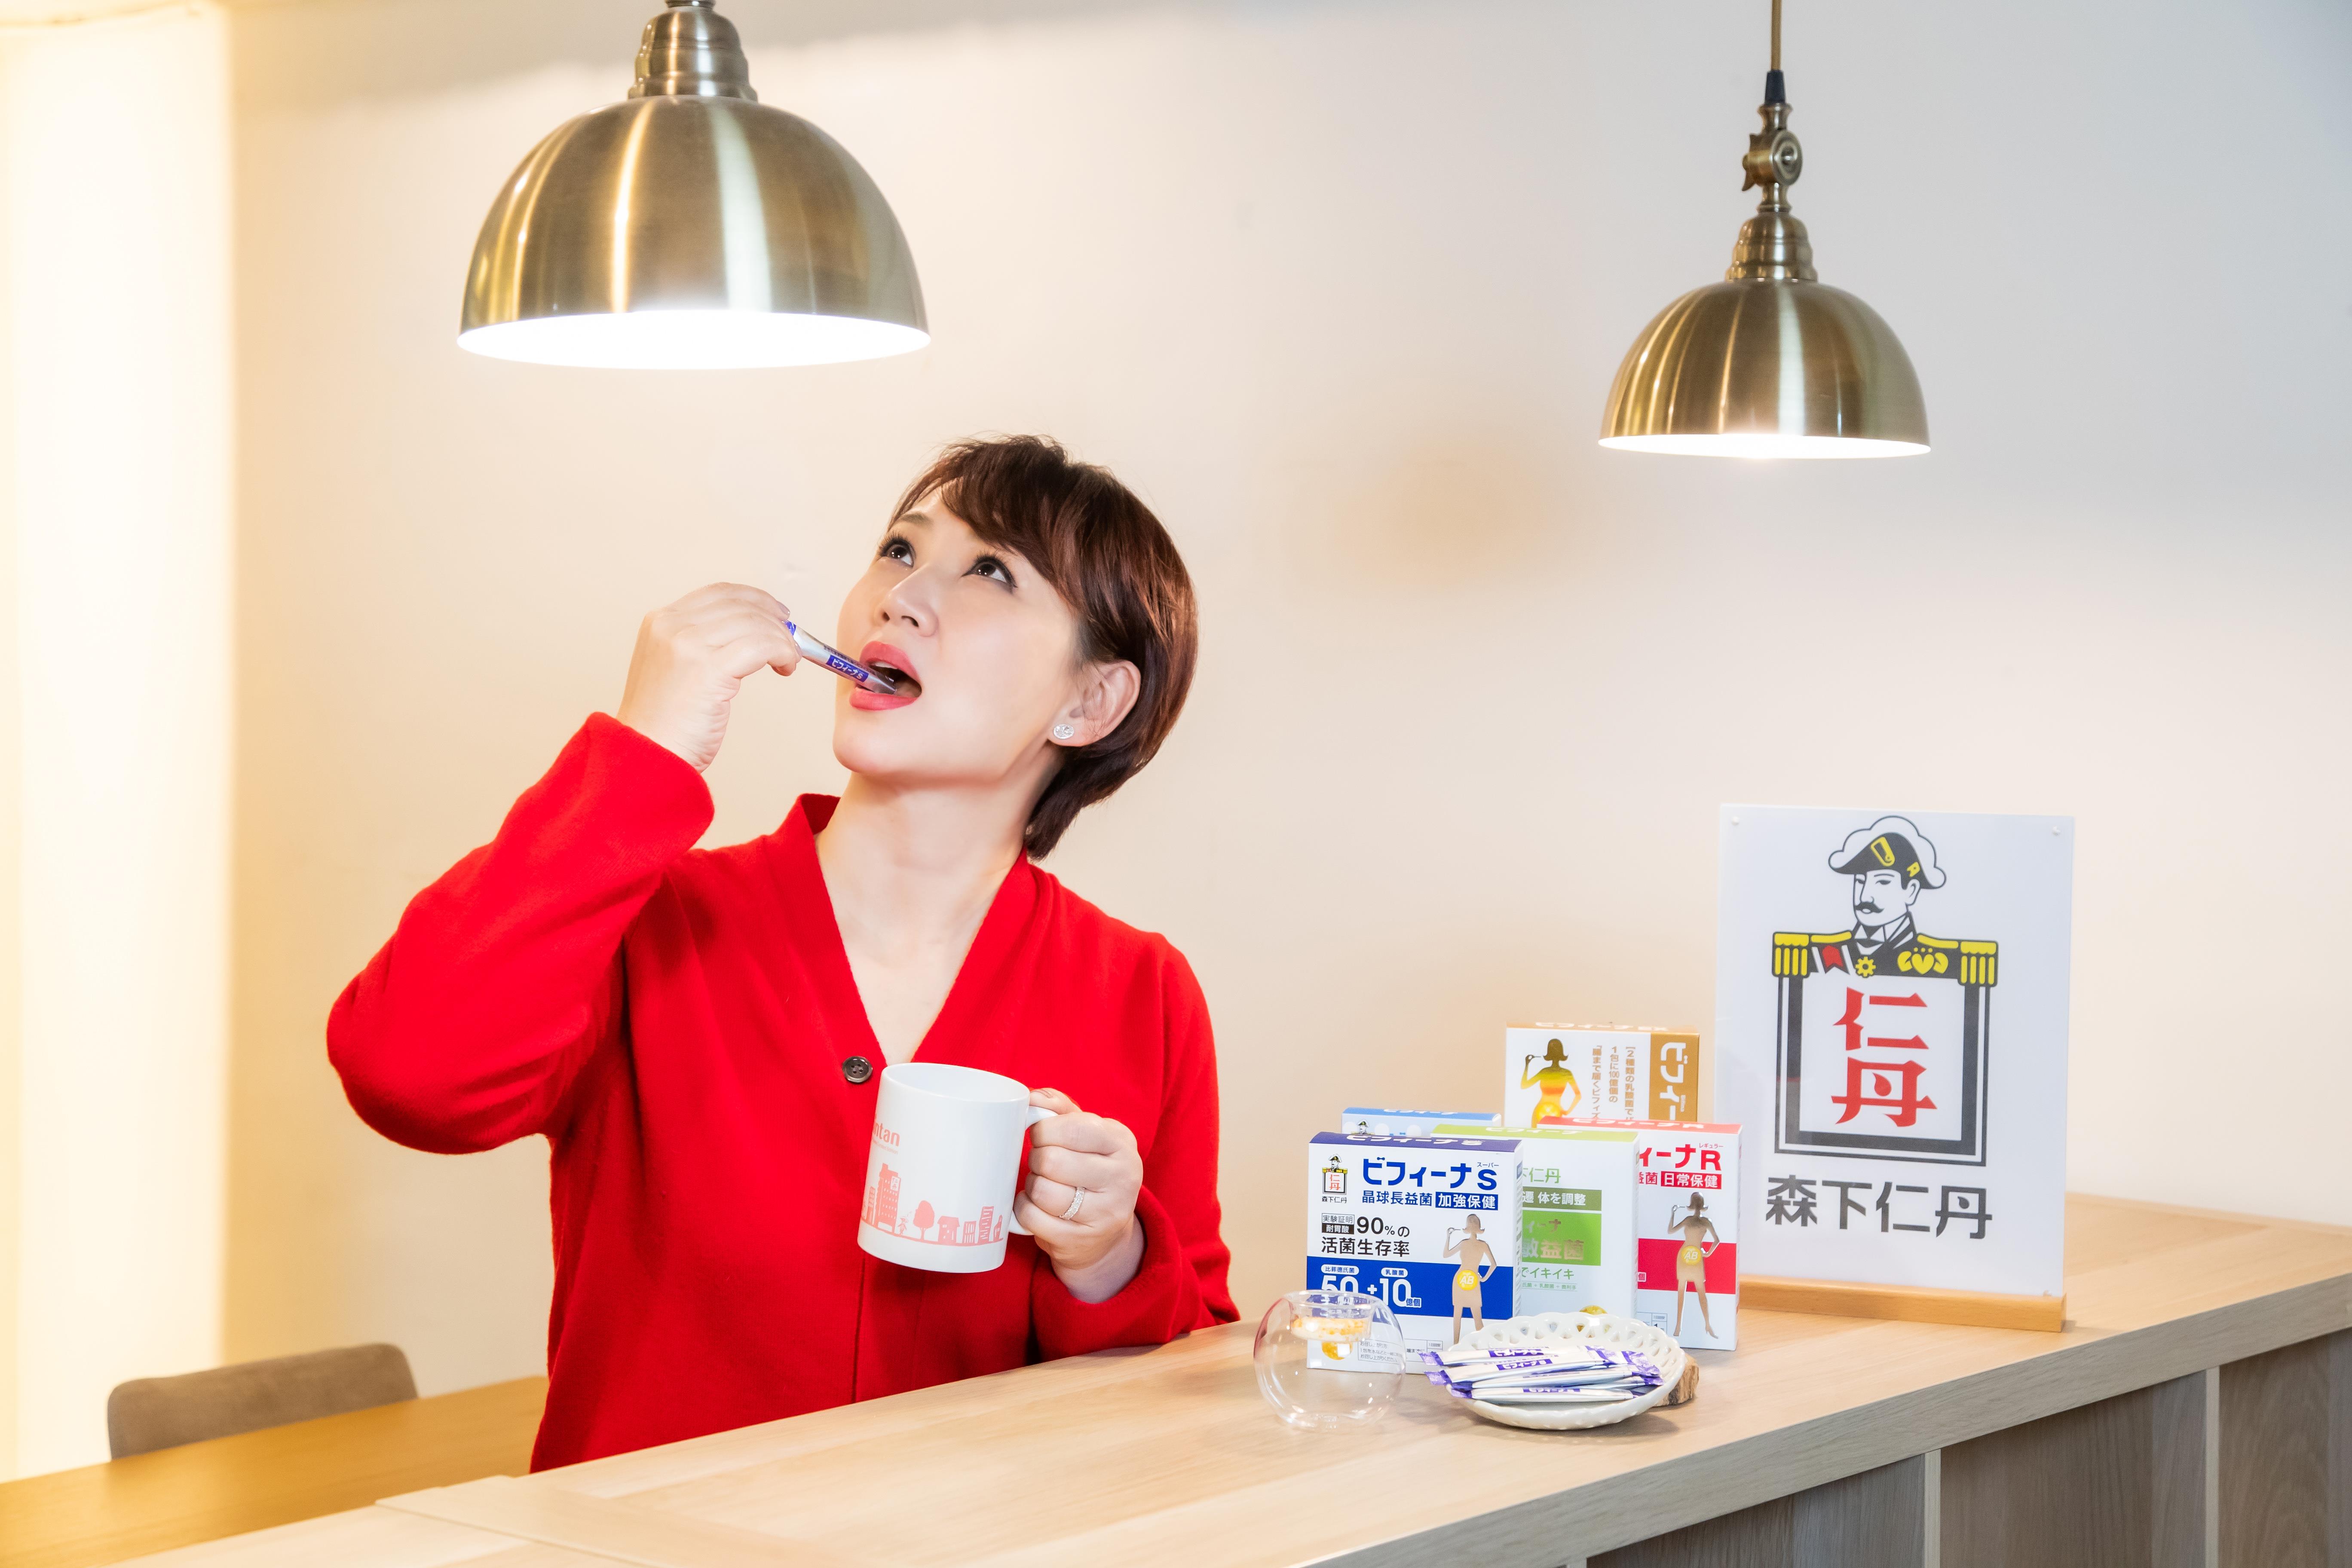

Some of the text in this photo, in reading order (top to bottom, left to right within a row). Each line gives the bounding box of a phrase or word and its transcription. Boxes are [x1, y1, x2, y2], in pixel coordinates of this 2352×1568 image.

[1831, 986, 1937, 1127] 仁丹
[1329, 1174, 1341, 1191] 仁丹
[1363, 1157, 1497, 1191] ビフィーナS
[1664, 1173, 1718, 1188] 日常保健
[1322, 1196, 1348, 1204] 森下仁丹
[1362, 1190, 1496, 1209] 晶球長益菌 加強保健
[1537, 1191, 1586, 1206] 体を調整
[1766, 1175, 1992, 1239] 森下仁丹
[1323, 1215, 1353, 1224] 実験証明
[1321, 1237, 1410, 1257] 活菌生存率
